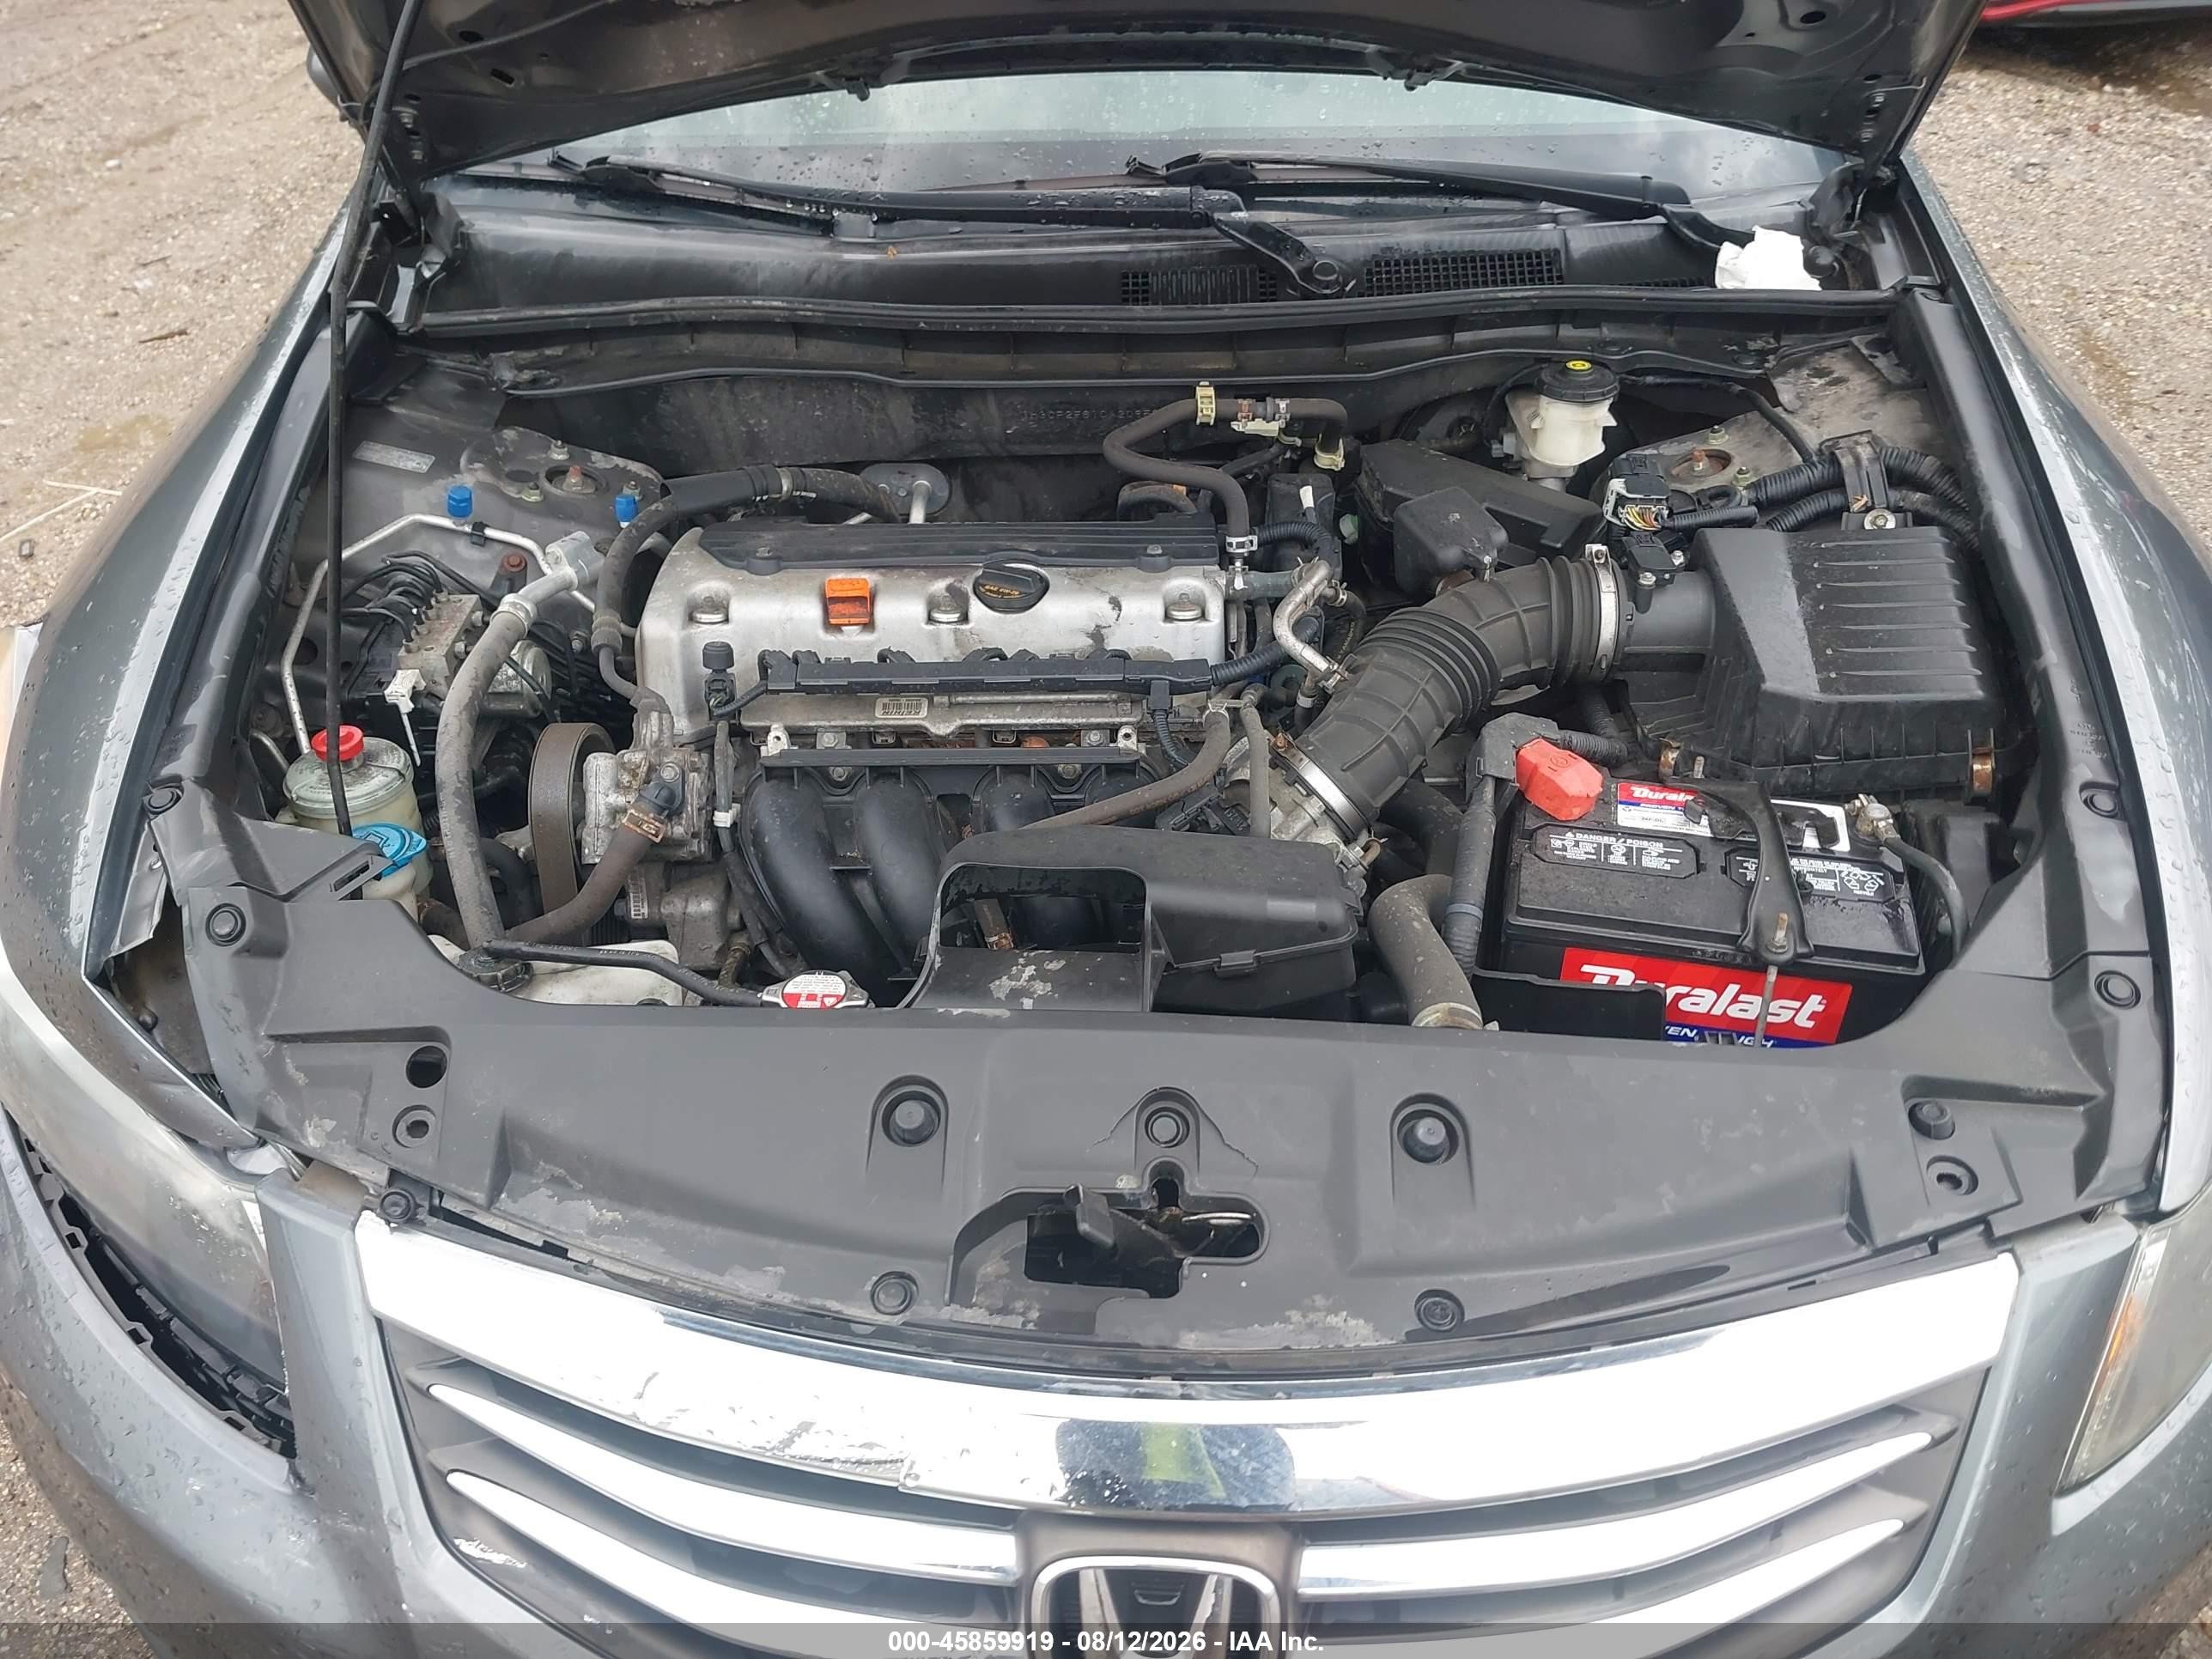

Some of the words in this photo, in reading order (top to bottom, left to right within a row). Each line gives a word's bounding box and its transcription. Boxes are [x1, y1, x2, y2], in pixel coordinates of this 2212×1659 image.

[1575, 832, 1617, 843] DANGER
[1626, 838, 1663, 849] POISON
[1580, 963, 1827, 1029] Dralast
